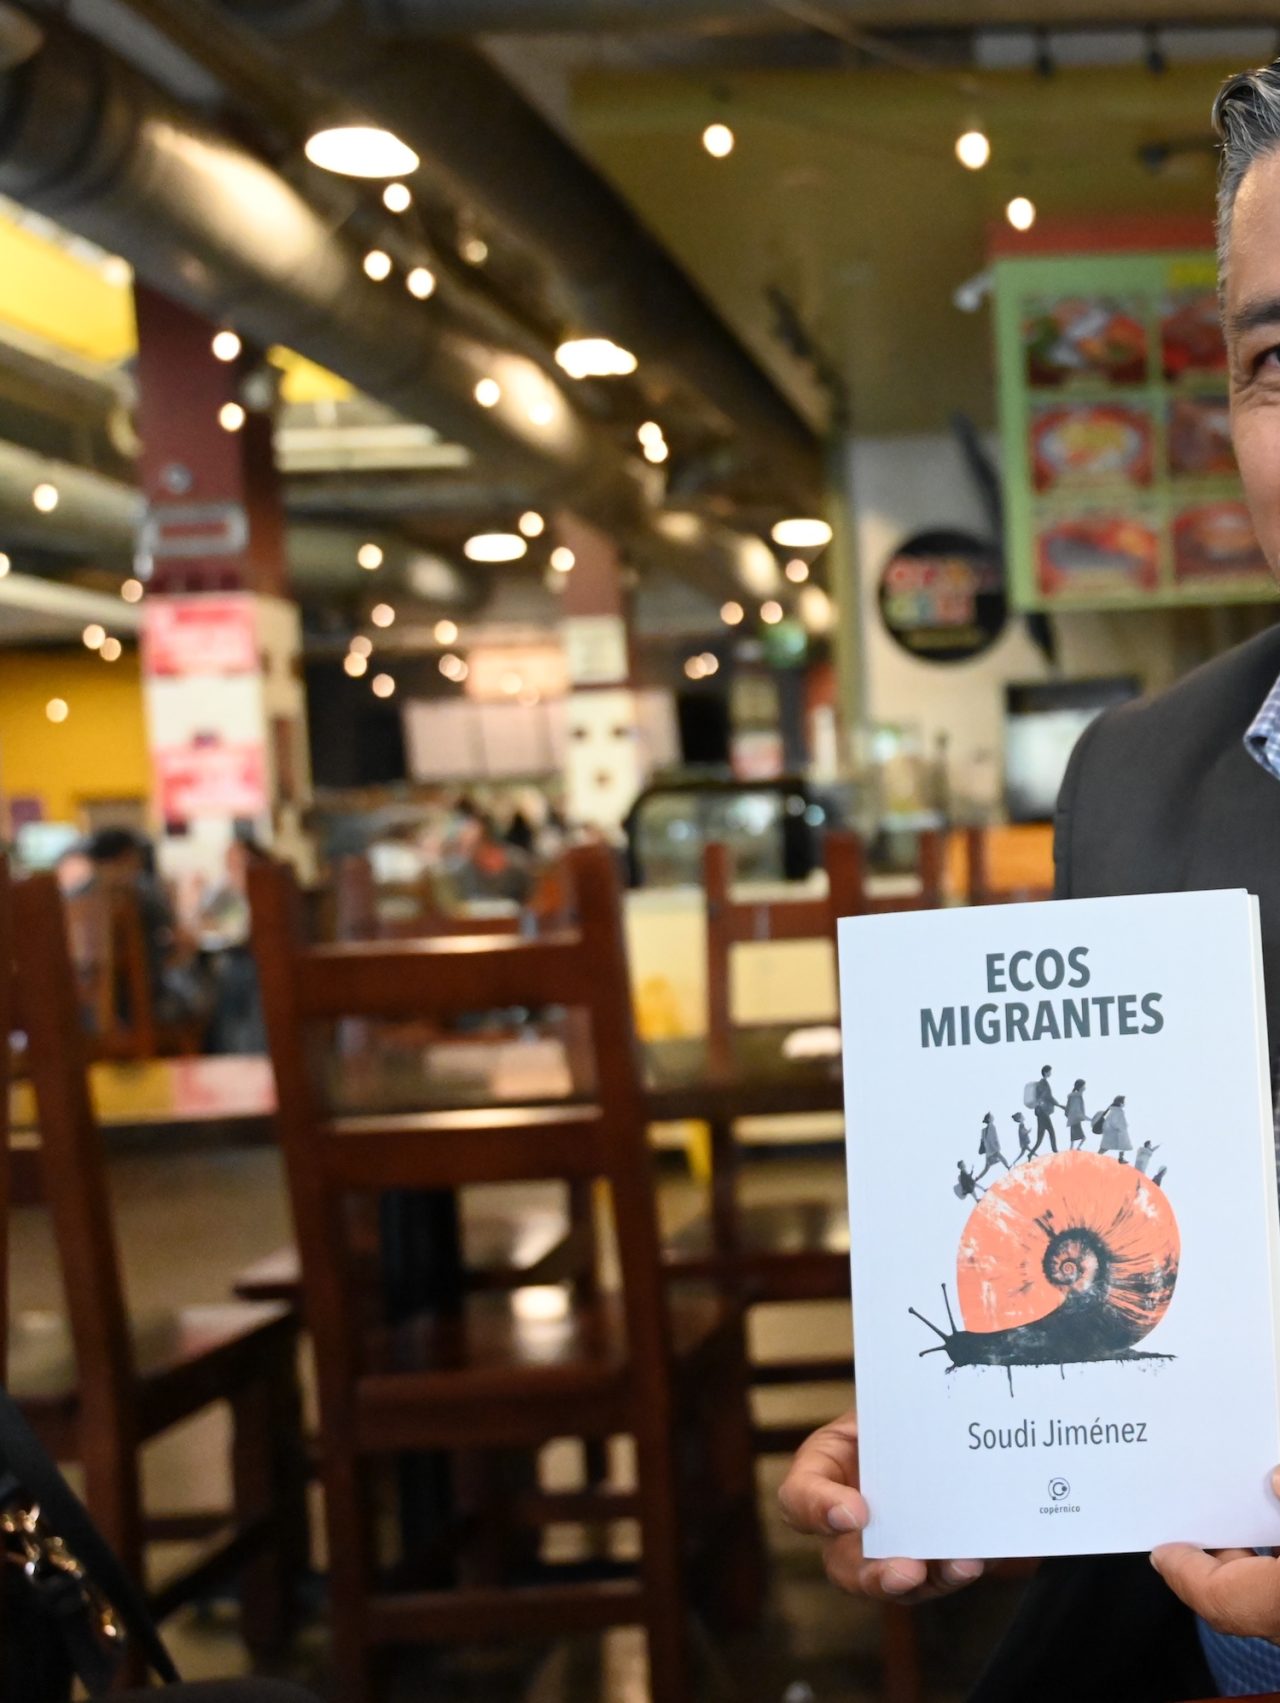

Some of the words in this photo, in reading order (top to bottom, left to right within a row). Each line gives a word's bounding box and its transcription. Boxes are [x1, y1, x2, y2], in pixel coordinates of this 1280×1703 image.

[986, 946, 1091, 993] ECOS
[920, 993, 1164, 1048] MIGRANTES
[968, 1419, 1036, 1450] Soudi
[1043, 1417, 1148, 1447] Jiménez
[1039, 1504, 1081, 1515] copérnico
